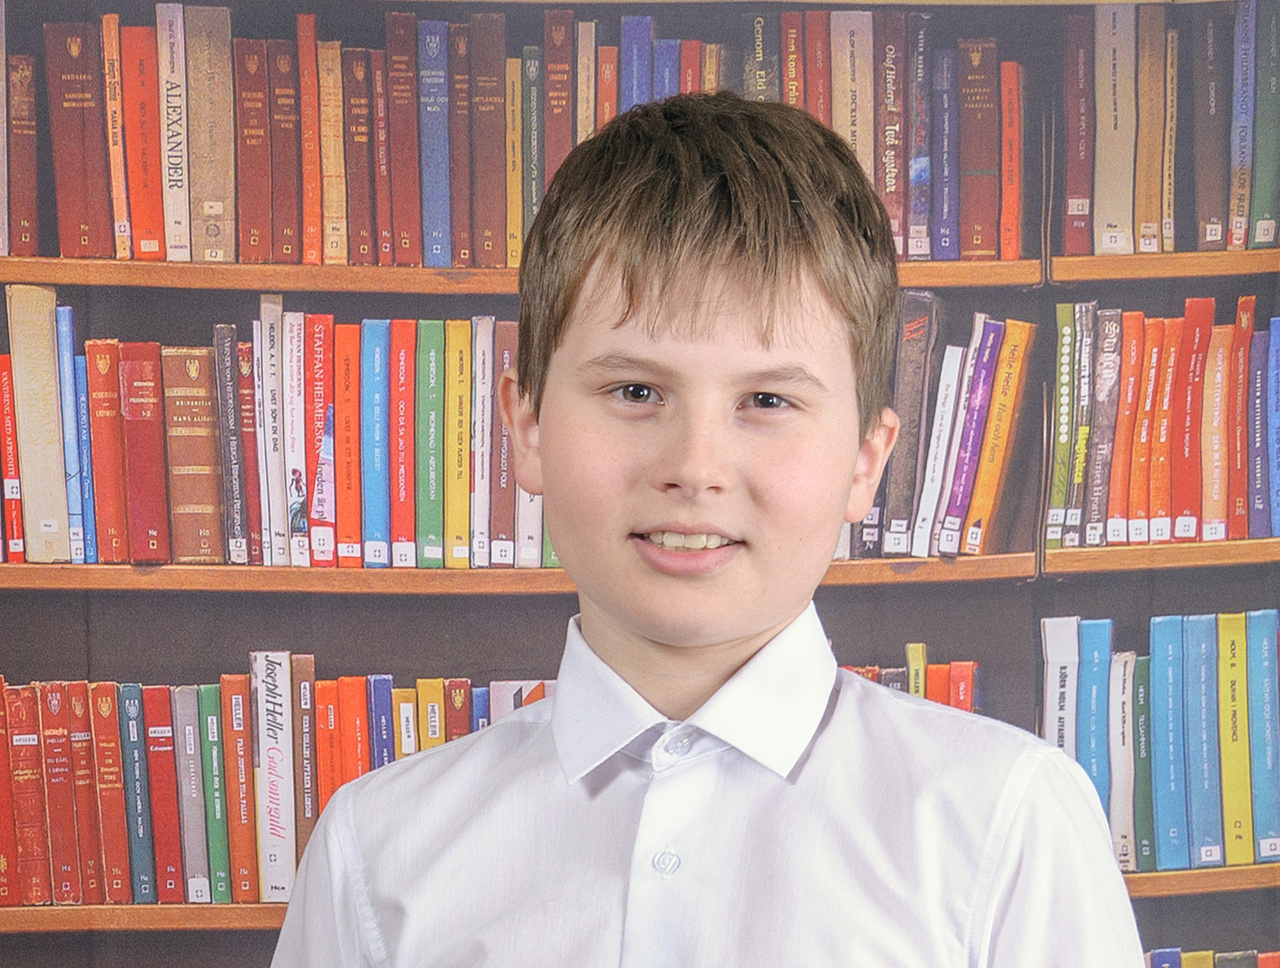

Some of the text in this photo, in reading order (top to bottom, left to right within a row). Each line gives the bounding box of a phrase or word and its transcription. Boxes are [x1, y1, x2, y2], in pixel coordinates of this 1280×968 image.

[754, 17, 765, 89] Genom Eld
[165, 80, 183, 189] ALEXANDER
[879, 45, 899, 192] Olof Hederyd Två systrar
[1, 371, 9, 413] VANDRING
[313, 324, 324, 454] STAFFAN HEIMERSON
[988, 344, 1019, 463] Helle Helle Hus och hem
[316, 498, 326, 506] är
[1090, 444, 1106, 522] Harriet Hjorth
[262, 655, 283, 699] Joseph
[233, 697, 242, 729] HELLER
[266, 699, 283, 744] Heller
[429, 705, 438, 736] HELLER
[1139, 715, 1147, 758] TILLSAMMANS
[267, 746, 284, 780] God
[268, 806, 286, 839] guld
